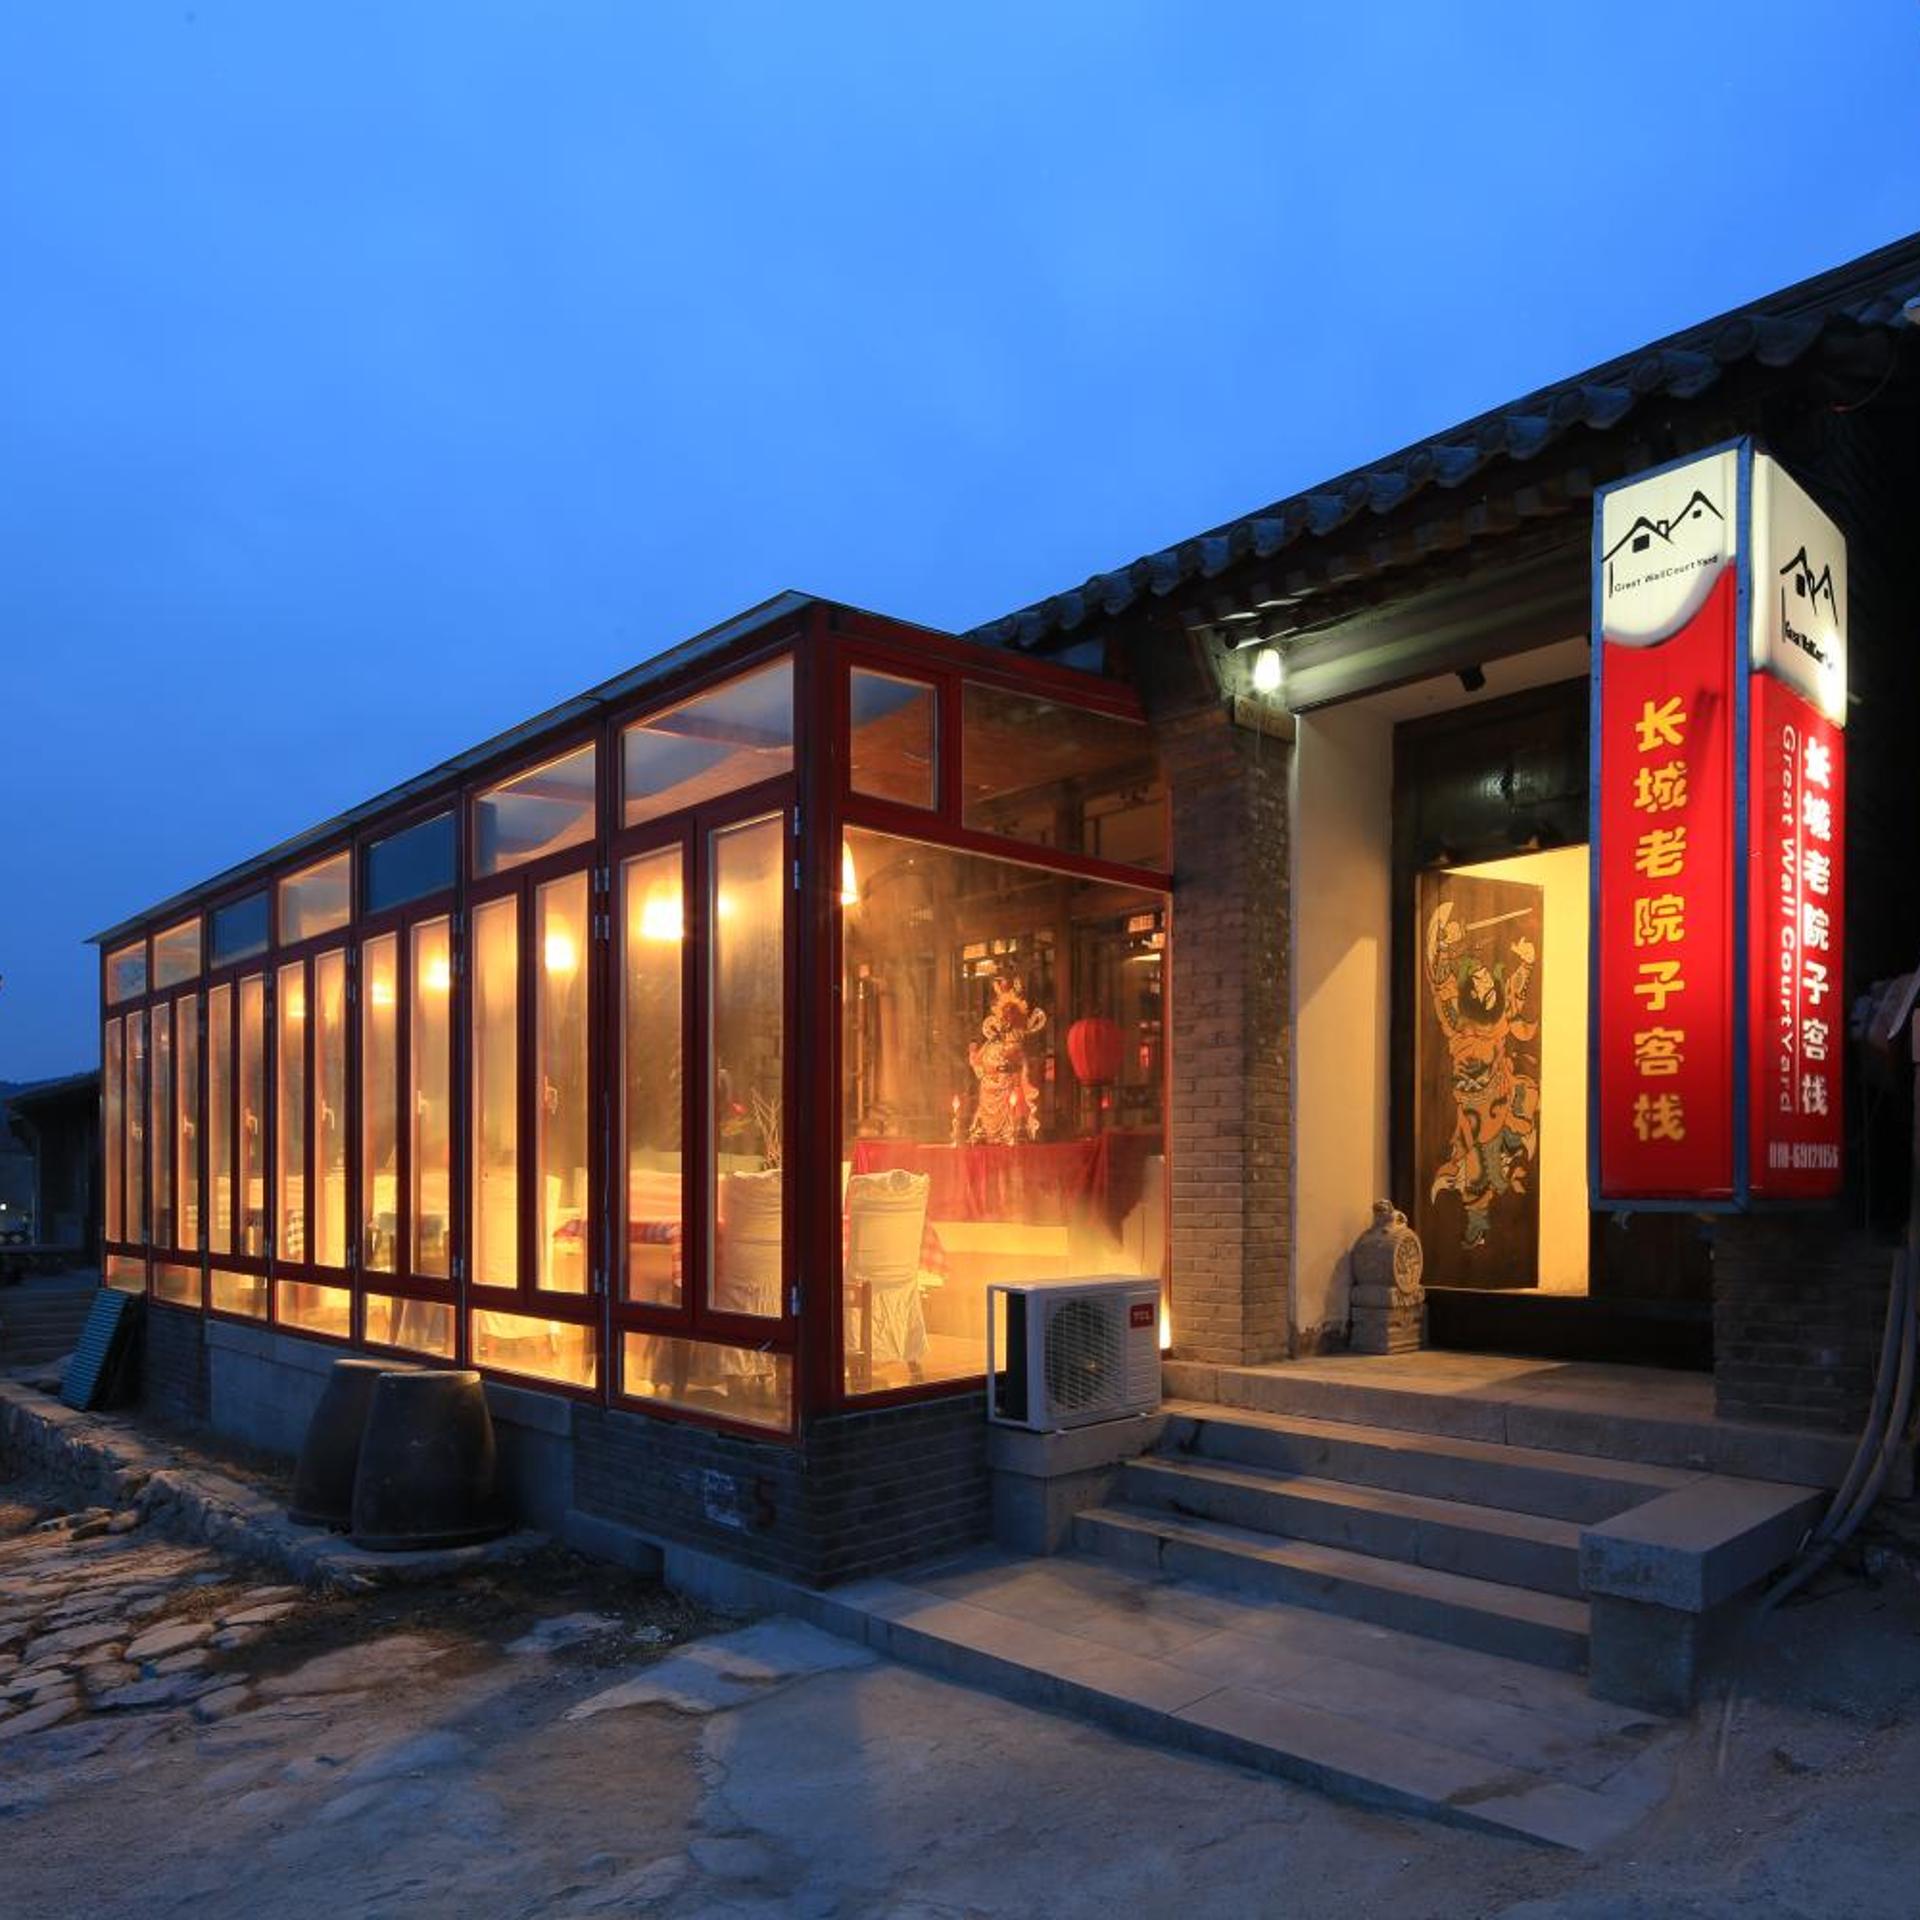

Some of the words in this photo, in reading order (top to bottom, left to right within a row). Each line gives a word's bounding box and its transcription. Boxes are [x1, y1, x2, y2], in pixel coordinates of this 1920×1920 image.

[1782, 724, 1797, 826] Great
[1633, 696, 1687, 1143] 长城老院子客栈
[1781, 838, 1796, 916] Wall
[1780, 925, 1796, 1028] Court
[1780, 1031, 1794, 1113] Yard
